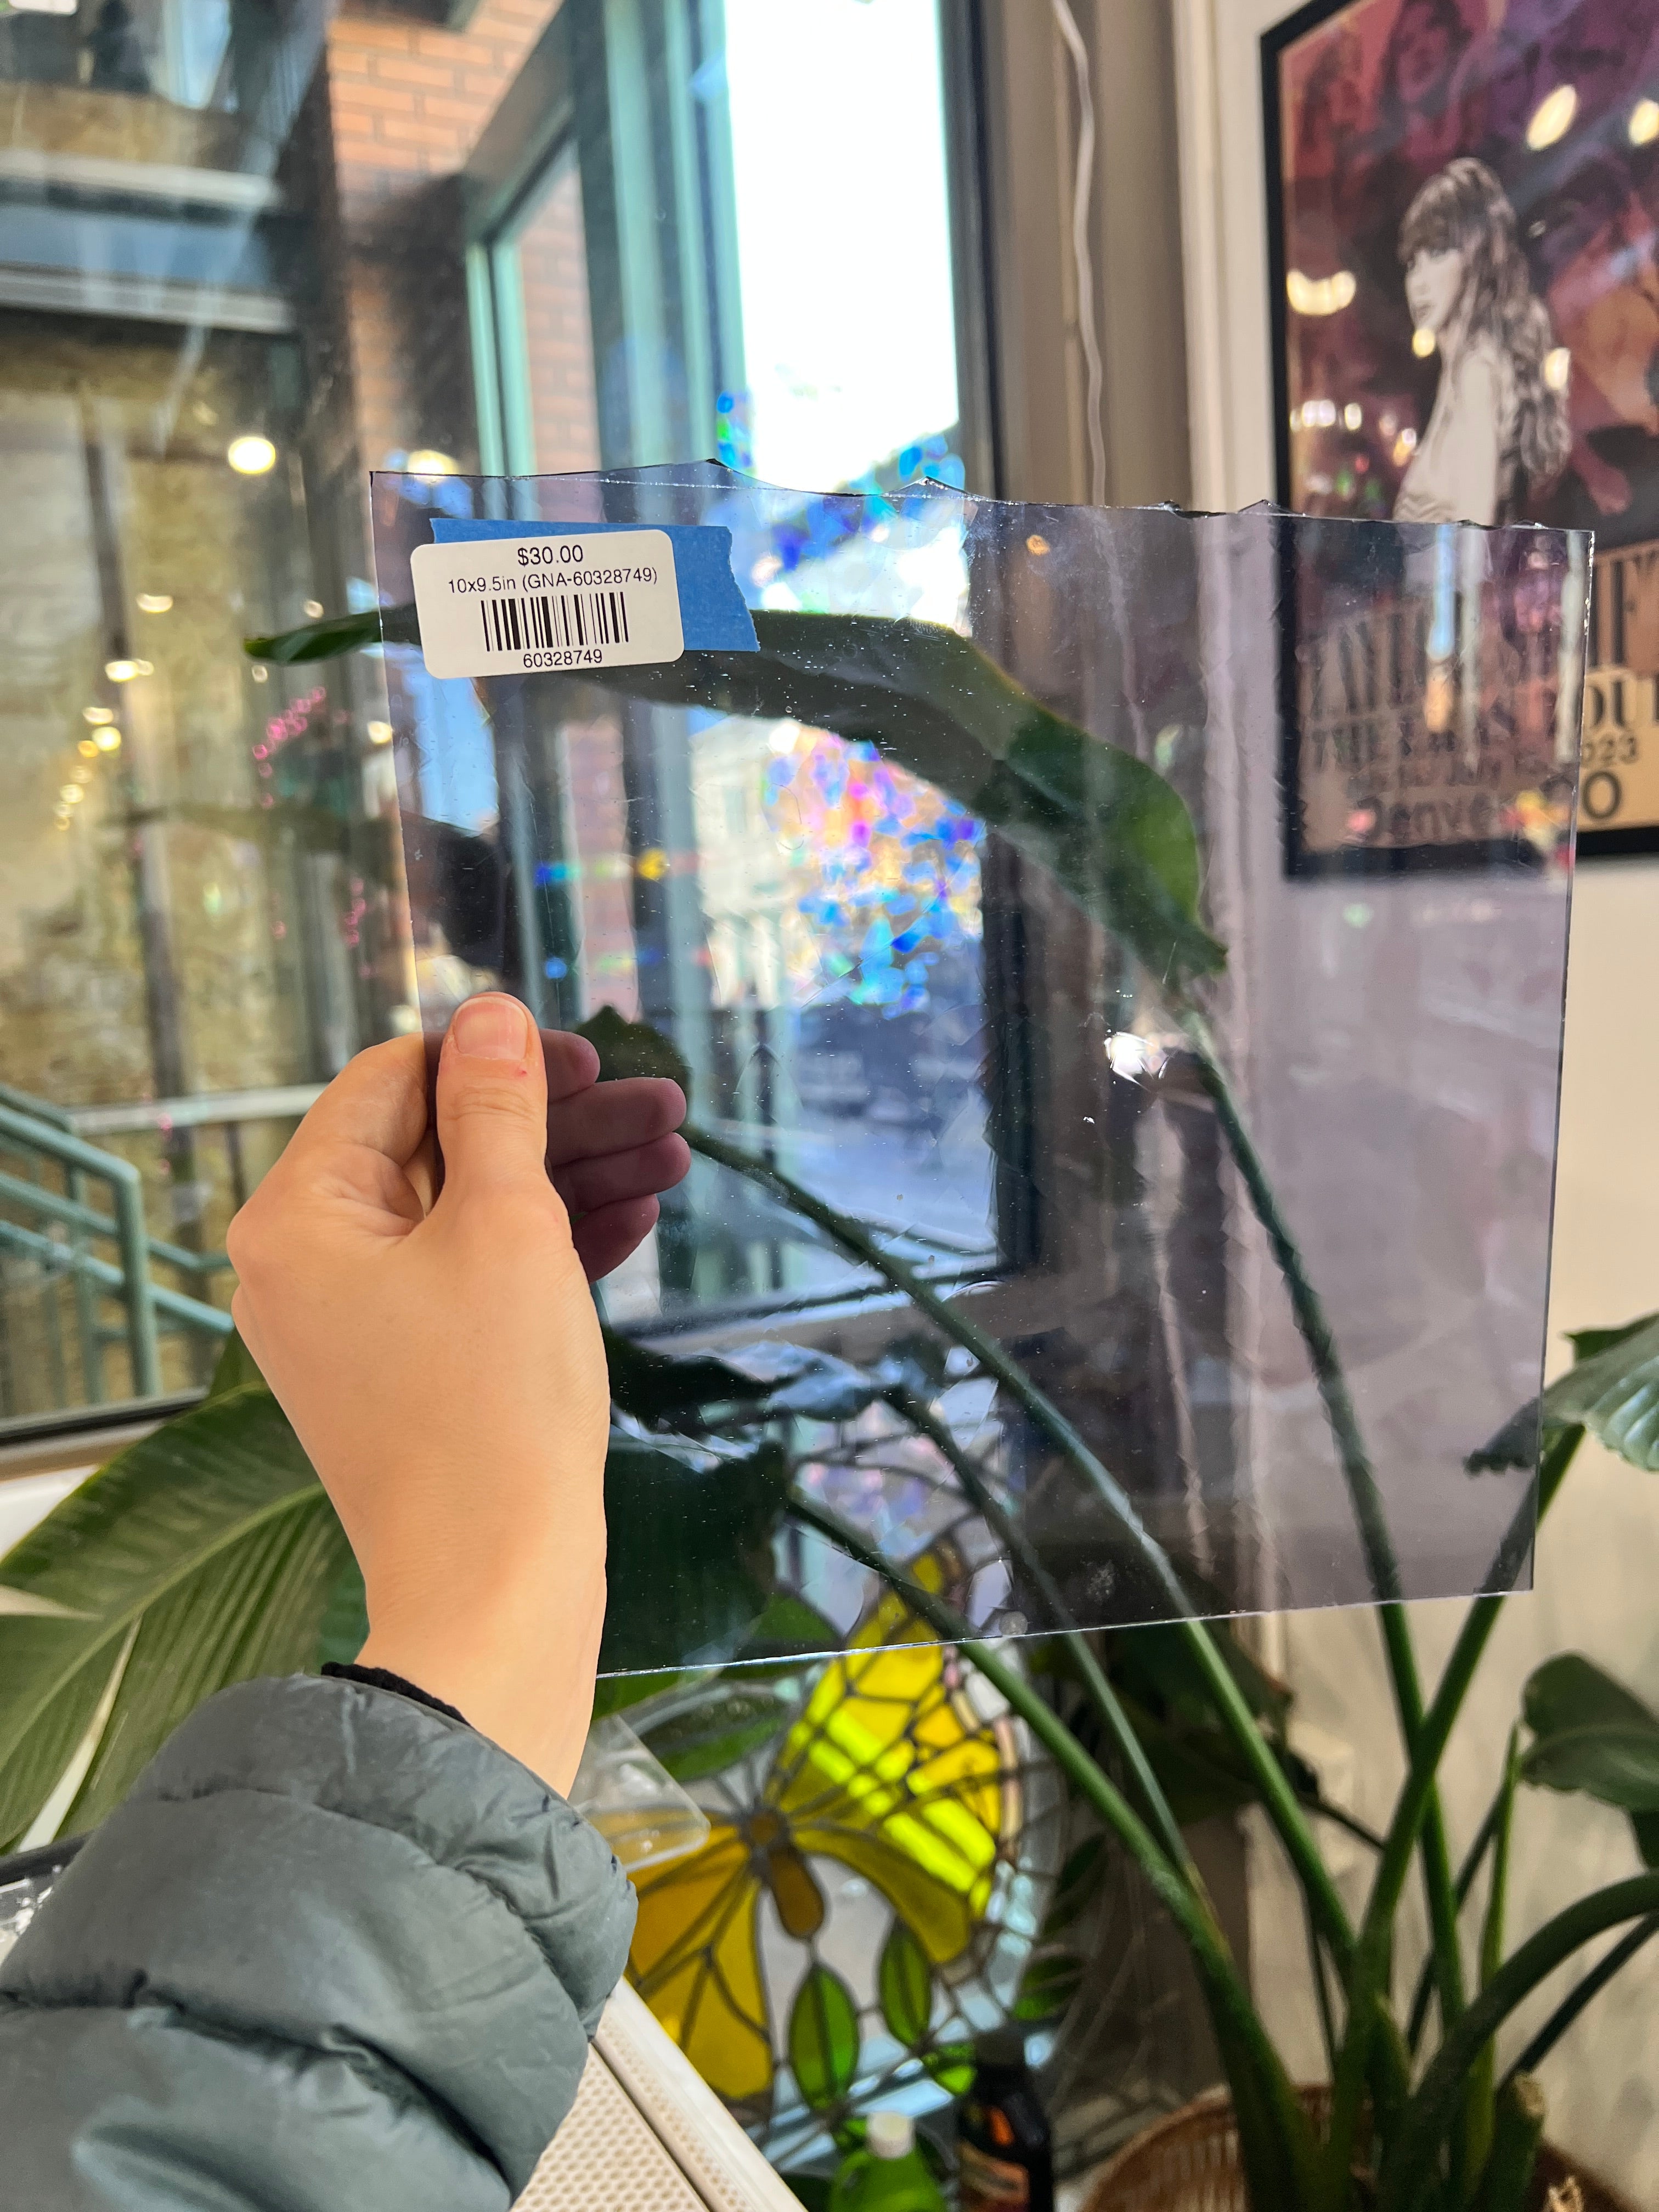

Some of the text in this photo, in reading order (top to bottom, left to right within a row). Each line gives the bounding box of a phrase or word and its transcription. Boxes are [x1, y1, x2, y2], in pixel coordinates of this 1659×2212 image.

[517, 544, 583, 567] $30.00
[448, 567, 657, 593] 10x9.5in (GNA-60328749)
[523, 648, 602, 668] 60328749
